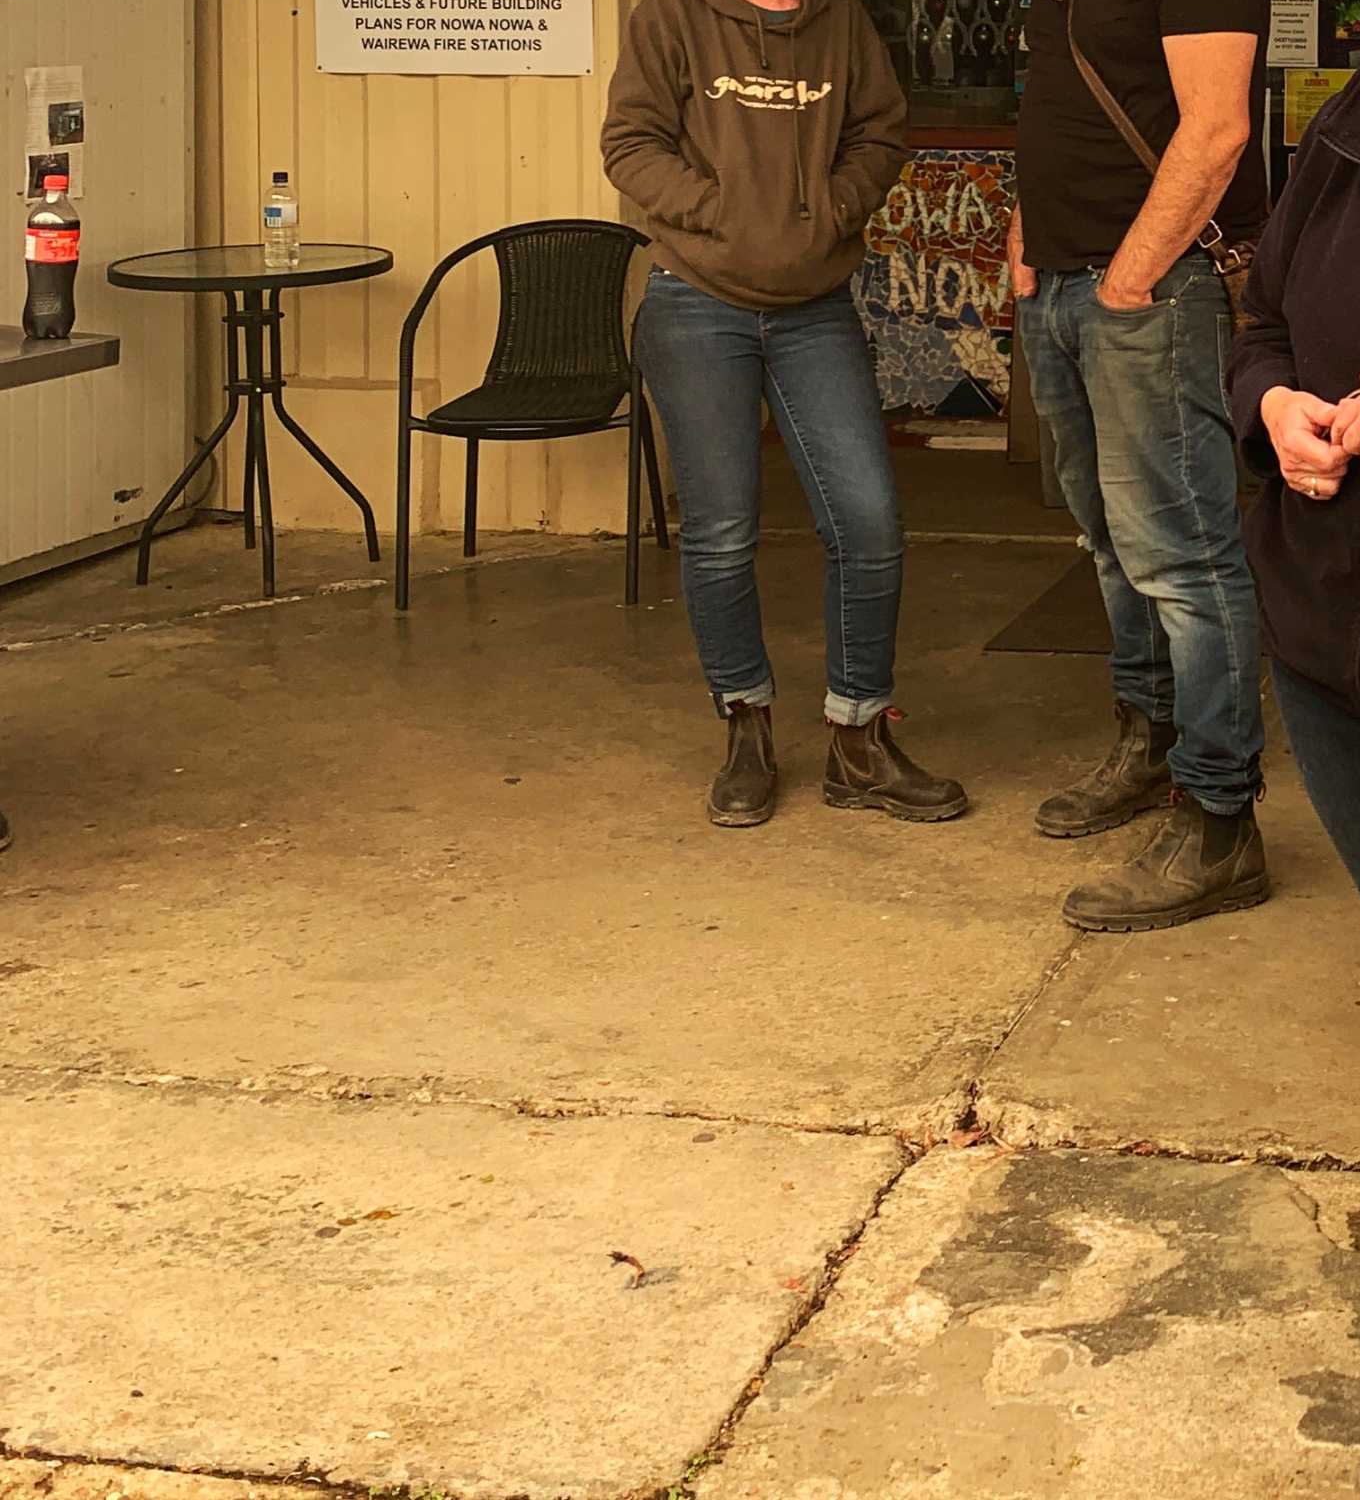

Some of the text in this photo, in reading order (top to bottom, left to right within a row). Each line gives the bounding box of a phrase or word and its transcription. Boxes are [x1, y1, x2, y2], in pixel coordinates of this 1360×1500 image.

[356, 18, 548, 32] PLANS FOR NOWA NOWA &
[361, 38, 542, 52] WAIREWA FIRE STATIONS
[885, 180, 993, 236] OWA
[888, 251, 1010, 315] NOW
